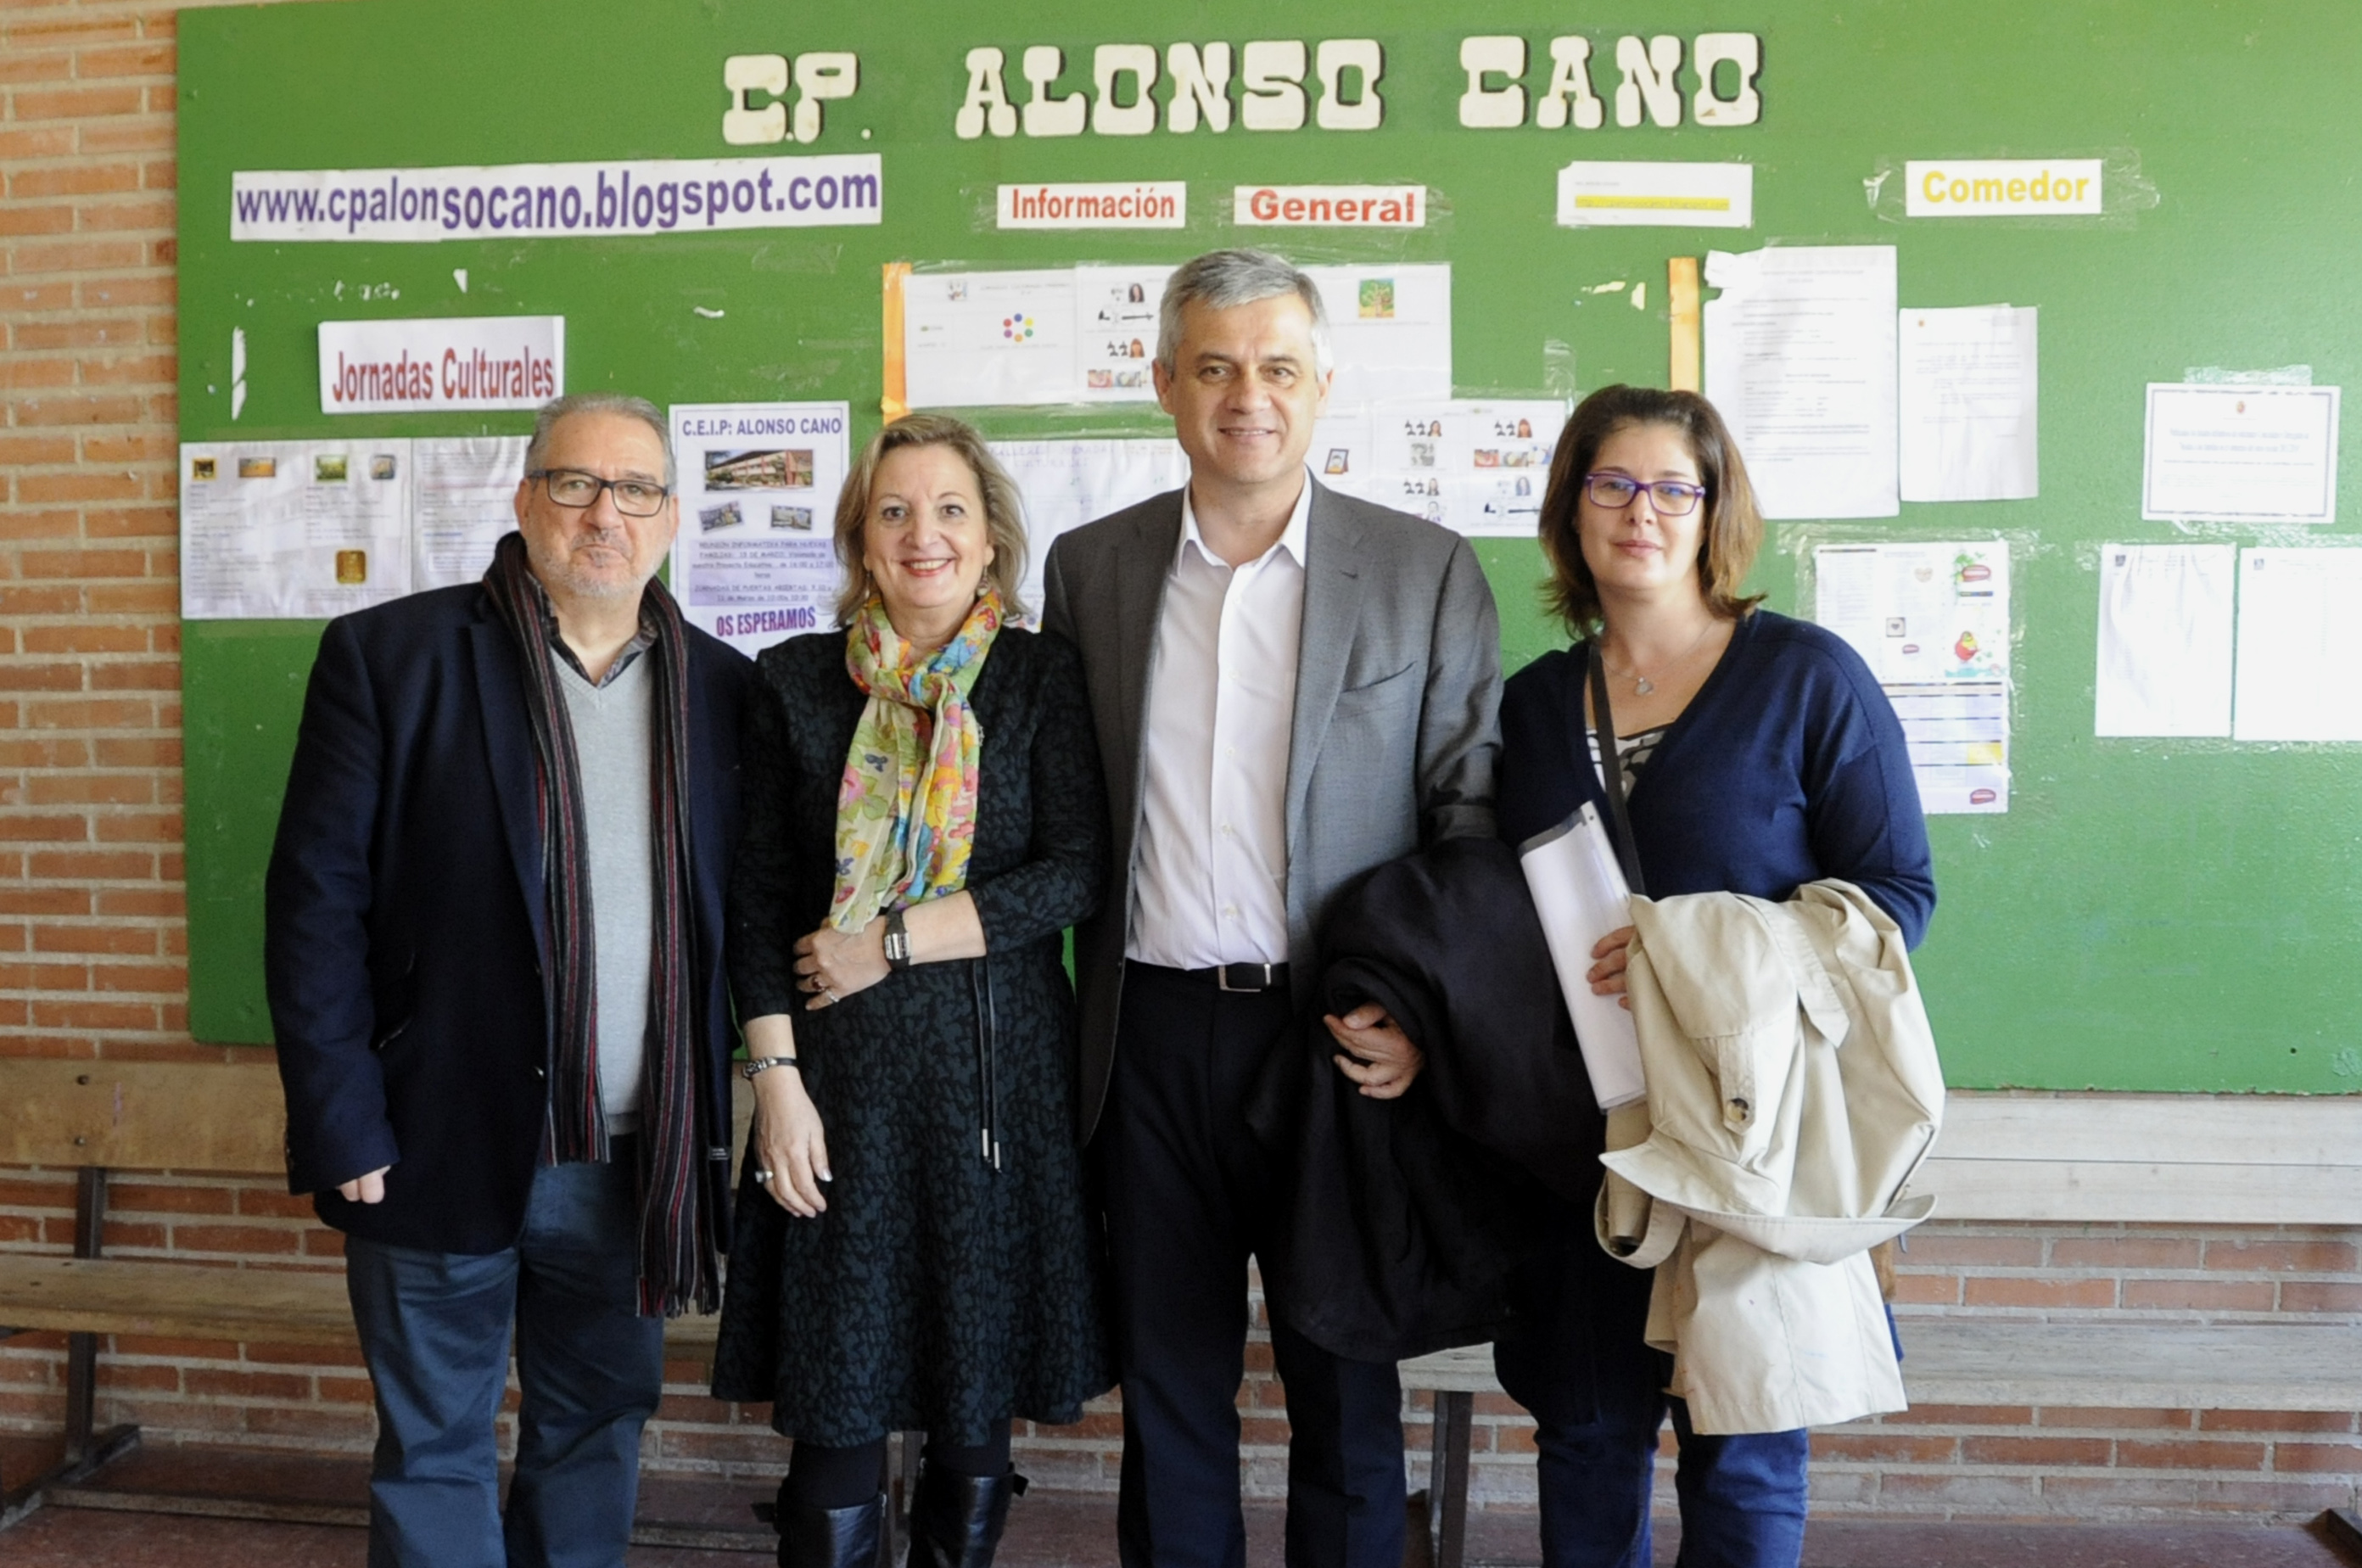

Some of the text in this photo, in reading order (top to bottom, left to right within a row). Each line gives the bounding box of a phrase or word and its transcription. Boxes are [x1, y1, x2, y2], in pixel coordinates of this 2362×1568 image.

[955, 39, 1381, 138] ALONSO
[1458, 32, 1760, 129] CANO
[236, 169, 879, 232] www.cpalonsocano.blogspot.com
[1011, 188, 1175, 219] Información
[1923, 170, 2090, 204] Comedor
[1250, 189, 1415, 222] General
[332, 345, 554, 403] Jornadas Culturales
[736, 418, 796, 435] ALONSO
[800, 417, 842, 434] CANO
[716, 607, 816, 638] OS ESPERAMOS
